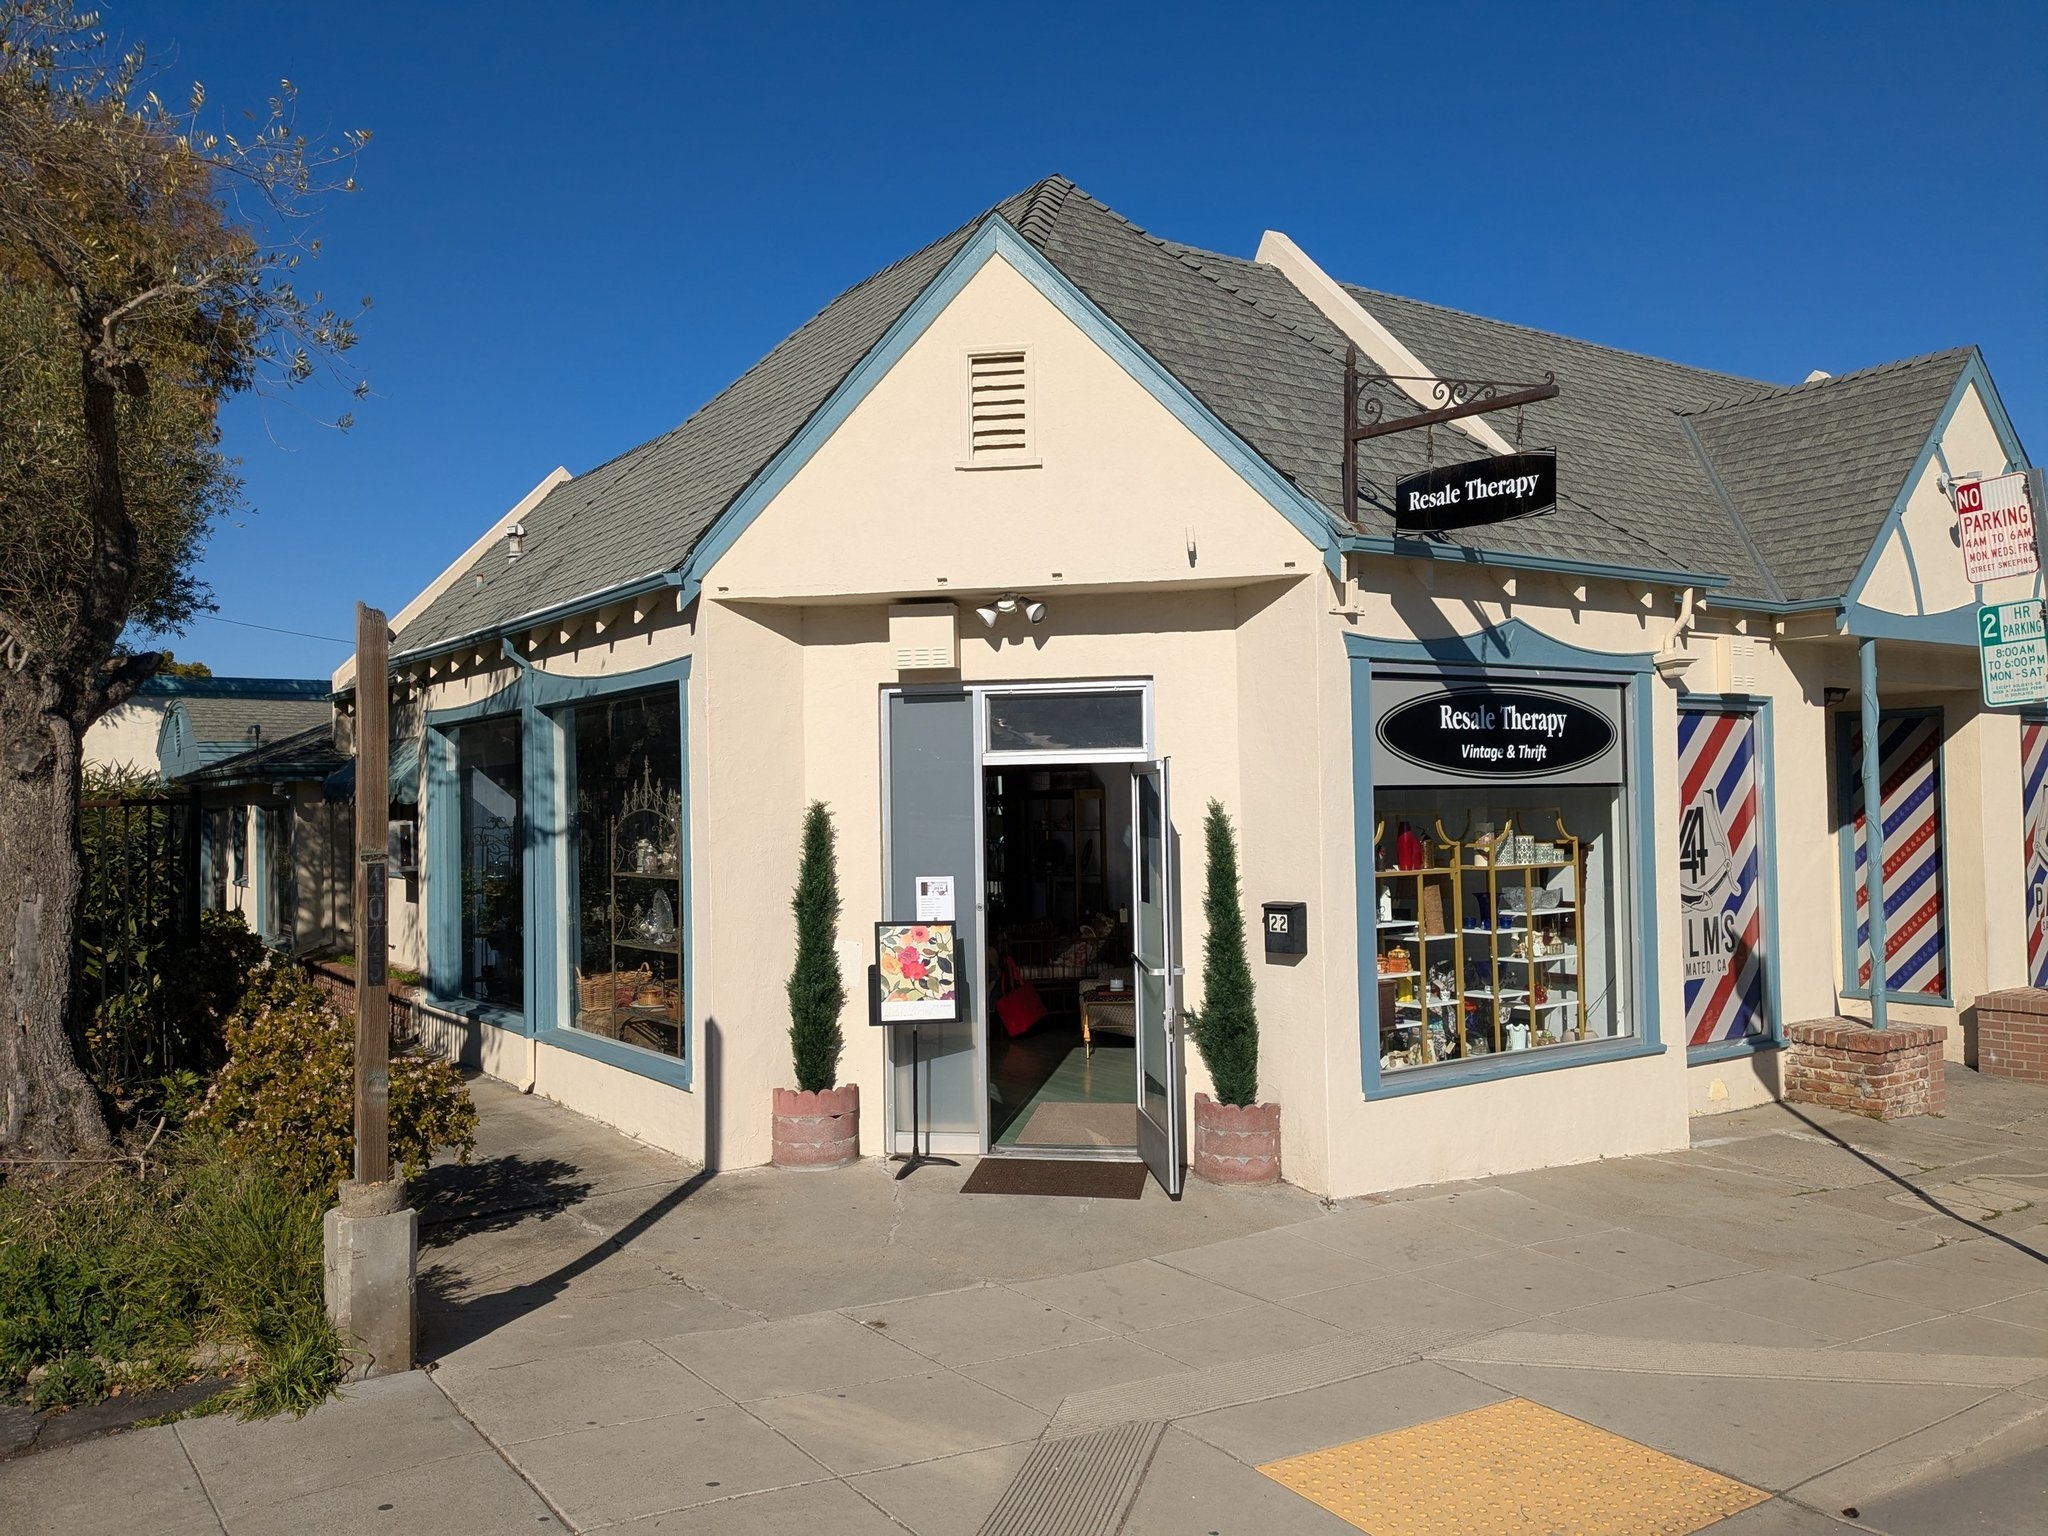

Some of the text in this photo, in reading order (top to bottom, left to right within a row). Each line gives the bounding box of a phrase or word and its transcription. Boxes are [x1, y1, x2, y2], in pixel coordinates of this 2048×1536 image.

[1409, 473, 1540, 511] Resale Therapy
[1957, 487, 1980, 509] NO
[1963, 505, 2028, 535] PARKING
[1965, 528, 2032, 548] 4AM TO 6AM
[1969, 551, 1990, 562] MON.
[1991, 545, 2017, 558] WEDS.
[1971, 556, 2033, 574] STREET SWEEPING
[2013, 605, 2031, 620] HR
[1982, 613, 1998, 639] 2
[2002, 619, 2042, 638] PARKING
[1996, 644, 2036, 658] 8:00AM
[1988, 655, 2046, 670] TO 6:00PM
[1439, 704, 1567, 737] Resale Therapy
[1461, 744, 1547, 761] Vintage & Thrift
[1271, 915, 1287, 931] 22
[1688, 914, 1736, 958] LMS
[1685, 958, 1727, 977] MATEO, CA
